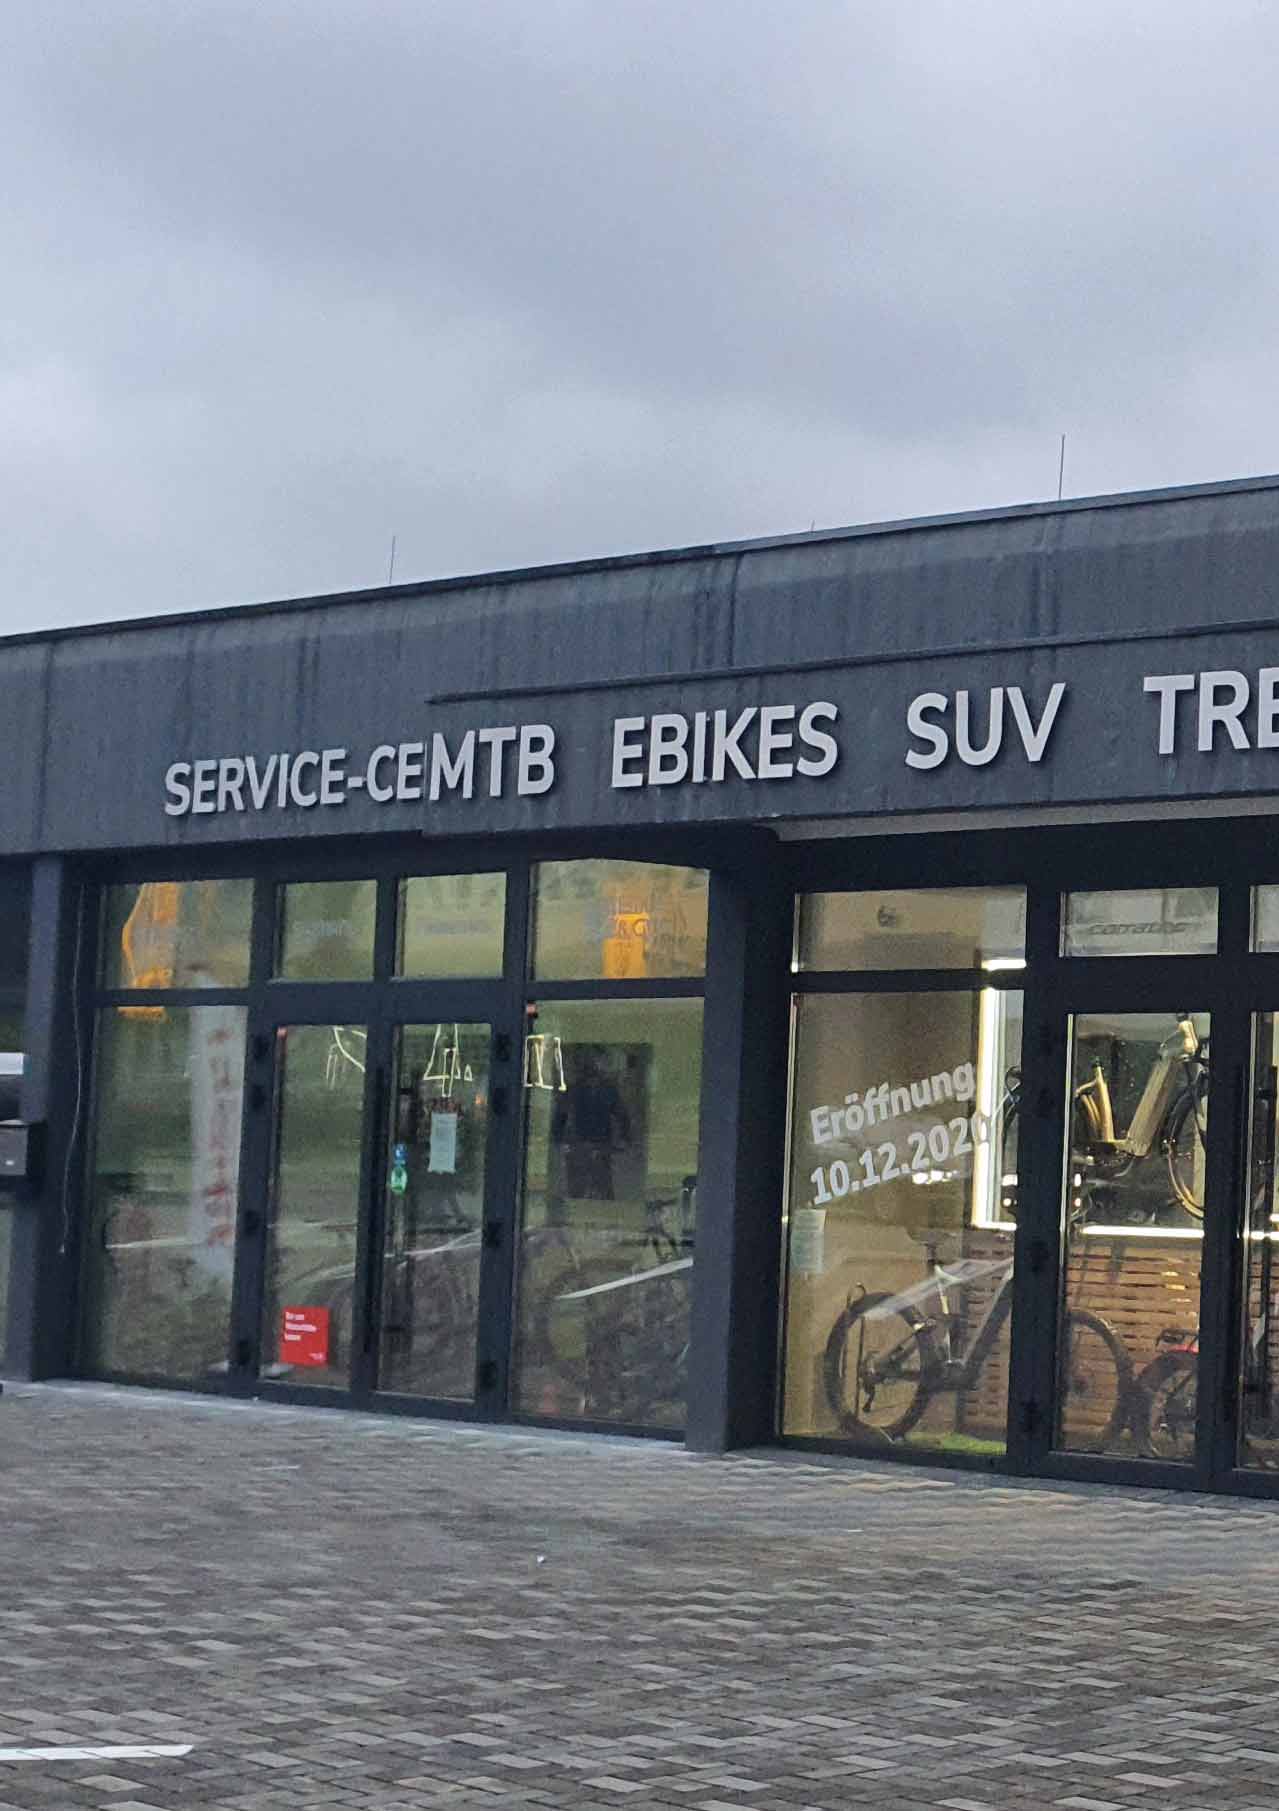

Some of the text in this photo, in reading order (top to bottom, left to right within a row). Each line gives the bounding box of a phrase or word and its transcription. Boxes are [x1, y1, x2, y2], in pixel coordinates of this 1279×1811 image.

[164, 742, 428, 816] SERVICE-CE
[429, 724, 556, 801] MTB
[611, 701, 839, 788] EBIKES
[905, 682, 1066, 770] SUV
[810, 1061, 977, 1145] Eröffnung
